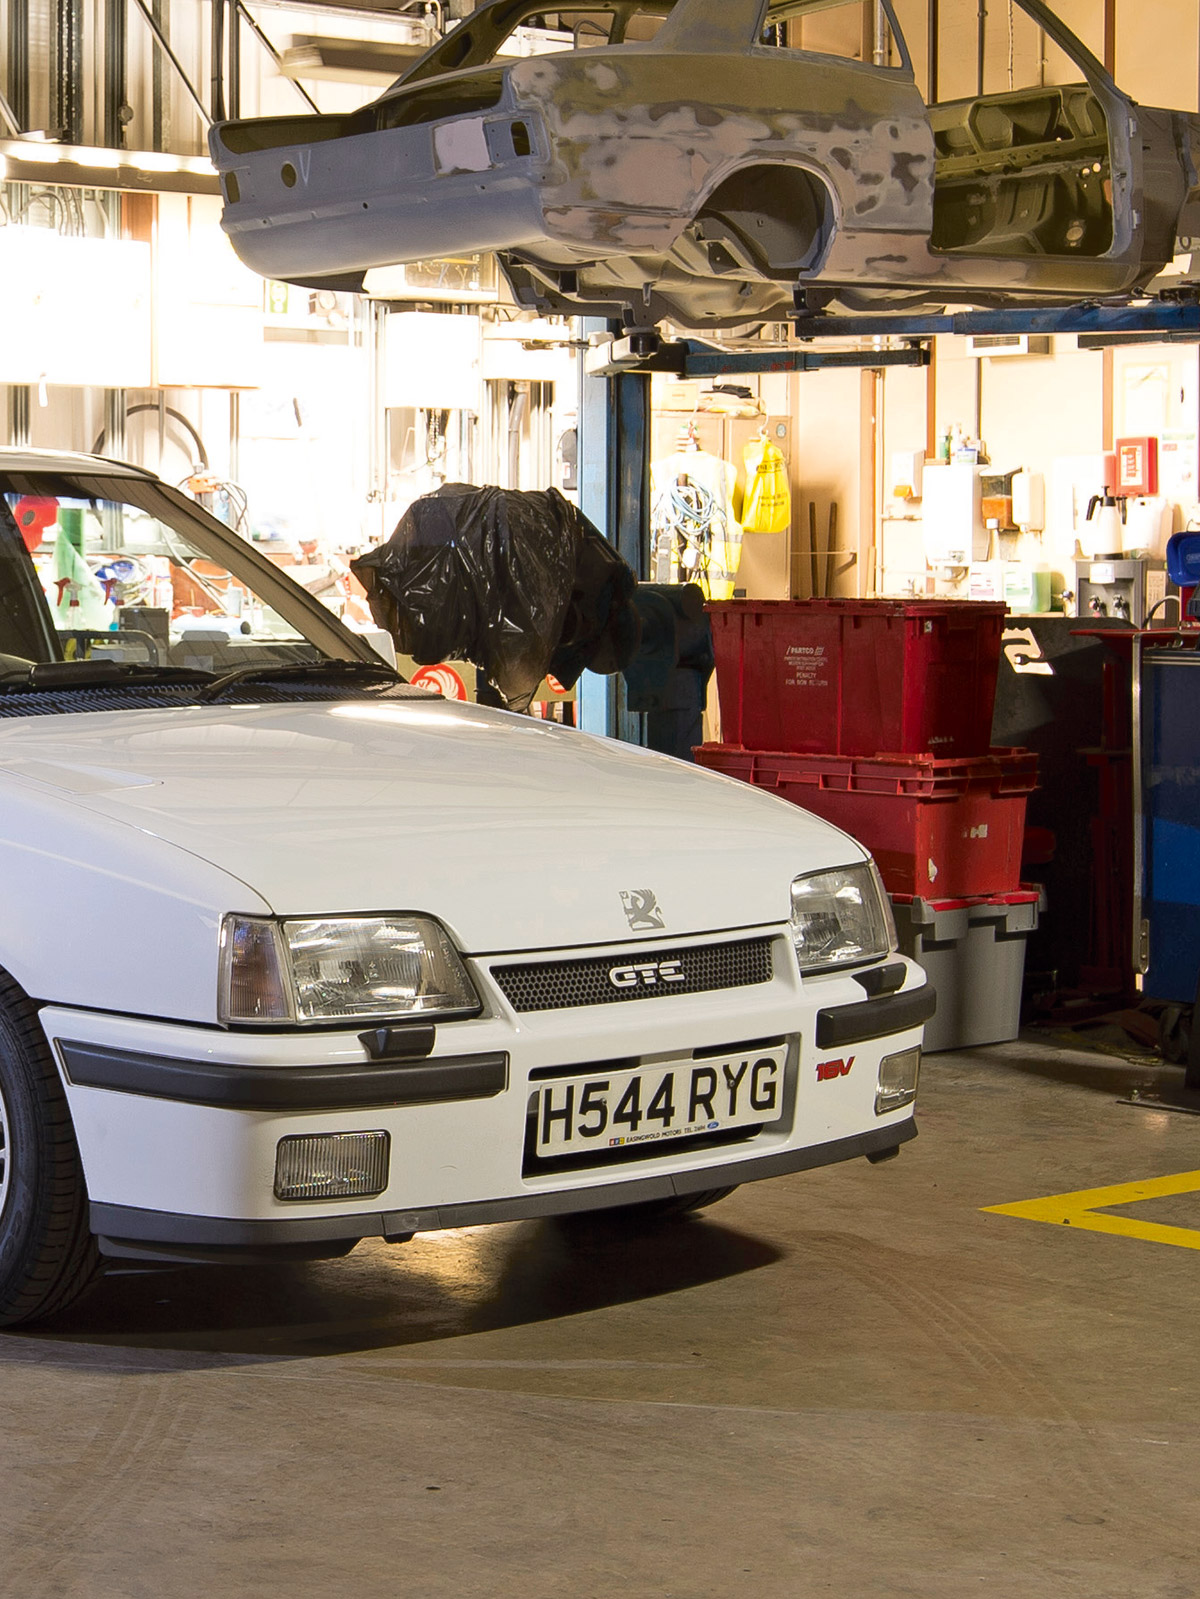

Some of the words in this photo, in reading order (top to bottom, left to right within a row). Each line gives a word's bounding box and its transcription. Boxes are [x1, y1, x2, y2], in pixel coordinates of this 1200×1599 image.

[609, 960, 685, 987] GTE
[815, 1055, 857, 1082] 16V
[542, 1072, 676, 1144] H544
[688, 1057, 778, 1123] RYG
[661, 1129, 682, 1138] MOTORS
